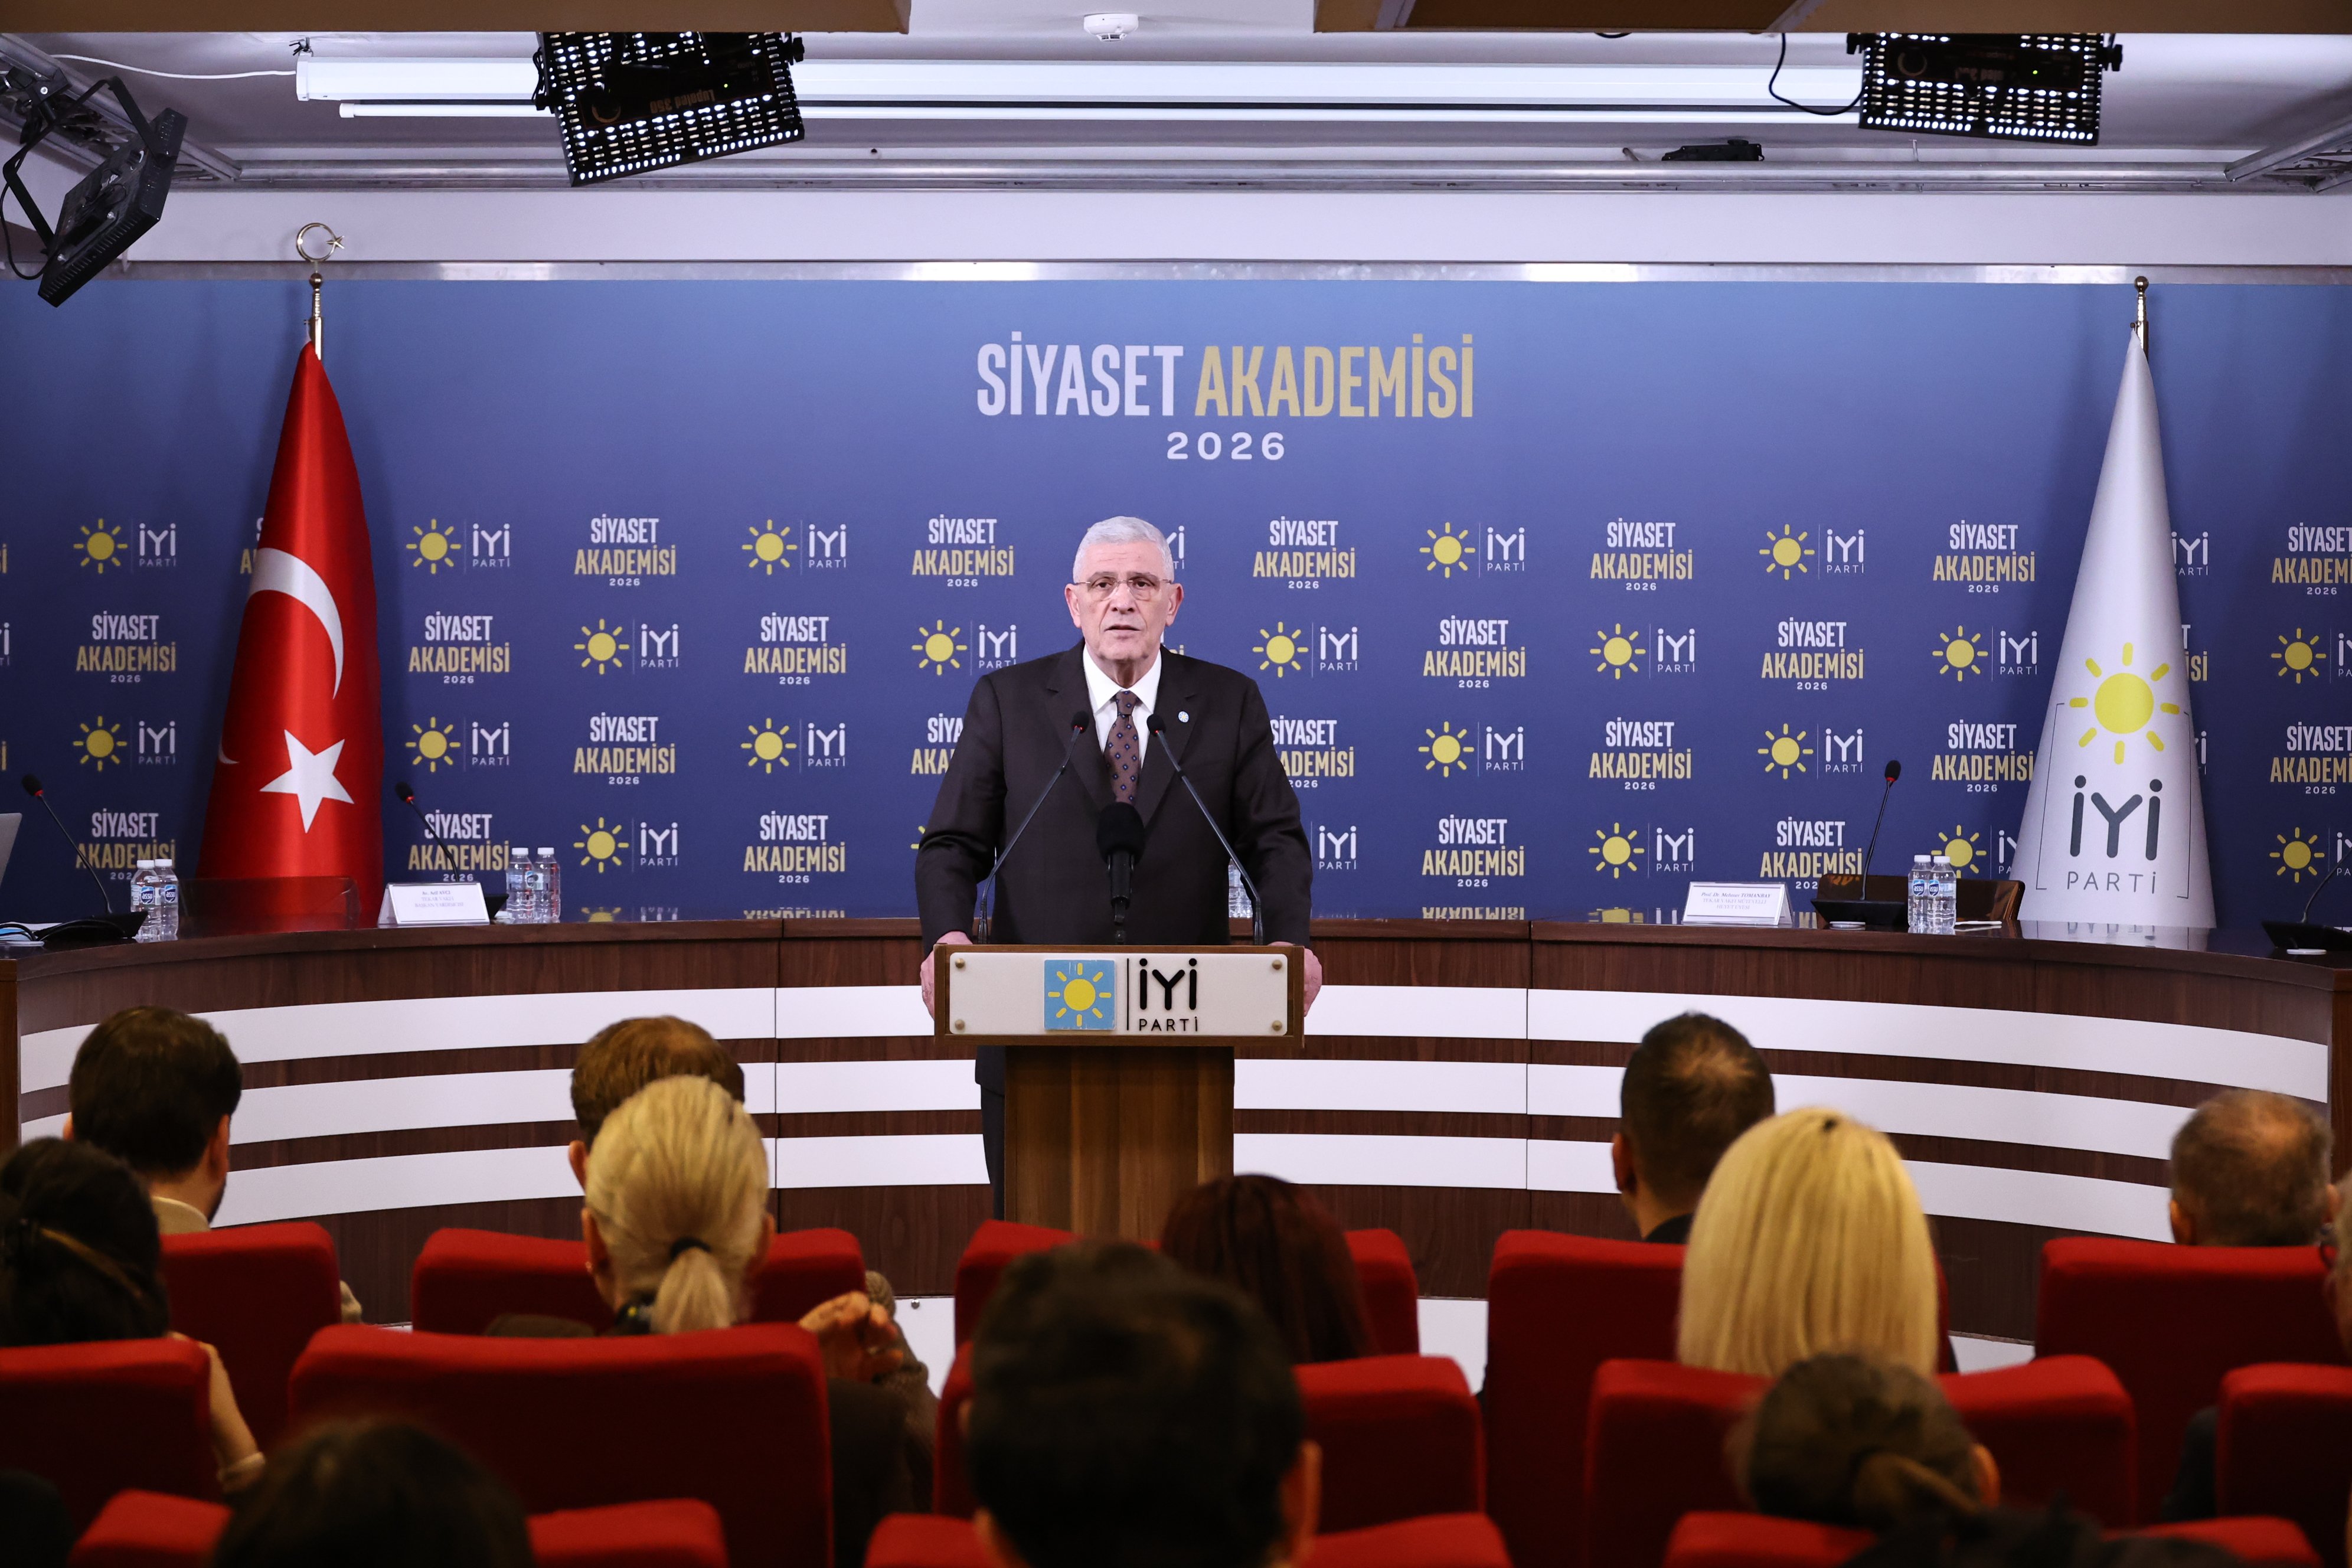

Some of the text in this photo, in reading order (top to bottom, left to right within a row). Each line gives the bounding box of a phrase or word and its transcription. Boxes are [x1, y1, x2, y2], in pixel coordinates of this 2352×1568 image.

[978, 331, 1473, 418] SİYASET AKADEMİSİ
[1168, 432, 1284, 460] 2026
[139, 523, 176, 556] İYİ
[473, 524, 509, 557] İYİ
[591, 514, 659, 543] SİYASET
[809, 524, 846, 557] İYİ
[929, 514, 997, 544] SİYASET
[1270, 516, 1338, 545] SİYASET
[1607, 518, 1675, 547] SİYASET
[1950, 520, 2018, 550] SİYASET
[1488, 527, 1524, 561] İYİ
[1827, 529, 1864, 563] İYİ
[139, 558, 176, 567] PARTİ
[473, 557, 509, 567] PARTİ
[574, 545, 675, 575] AKADEMİSİ
[809, 558, 846, 568] PARTİ
[912, 545, 1014, 576] AKADEMİSİ
[1253, 547, 1355, 578] AKADEMİSİ
[1487, 561, 1524, 571] PARTİ
[1590, 549, 1692, 580] AKADEMİSİ
[1827, 563, 1864, 573] PARTİ
[1933, 551, 2034, 582] AKADEMİSİ
[2178, 566, 2208, 576] ARTİ
[948, 579, 978, 587] 2026
[1968, 584, 1998, 593] 2026
[92, 610, 159, 640] SİYASET
[425, 611, 493, 641] SİYASET
[641, 623, 678, 657] İYİ
[761, 612, 829, 642] SİYASET
[1440, 615, 1508, 645] SİYASET
[1778, 617, 1847, 647] SİYASET
[76, 642, 176, 671] AKADEMİSİ
[979, 625, 1016, 658] İYİ
[1320, 626, 1357, 660] İYİ
[1658, 628, 1695, 662] İYİ
[2000, 631, 2037, 664] İYİ
[409, 642, 509, 672] AKADEMİSİ
[641, 658, 678, 668] PARTİ
[744, 643, 846, 673] AKADEMİSİ
[1320, 661, 1357, 671] PARTİ
[1423, 646, 1525, 677] AKADEMİSİ
[1658, 663, 1694, 672] PARTİ
[1762, 648, 1863, 679] AKADEMİSİ
[2000, 665, 2037, 675] PARTİ
[444, 675, 474, 684] 2026
[1797, 682, 1827, 690] 2026
[139, 721, 175, 754] İYİ
[472, 722, 509, 755] İYİ
[590, 712, 658, 741] SİYASET
[808, 723, 845, 756] İYİ
[927, 713, 963, 743] SİYA
[1606, 717, 1674, 747] SİYASET
[1948, 719, 2017, 749] SİYASET
[574, 743, 675, 773] AKADEMİSİ
[1486, 726, 1523, 760] İYİ
[1825, 729, 1863, 762] İYİ
[139, 756, 175, 764] PARTİ
[472, 756, 509, 765] PARTİ
[808, 757, 845, 766] PARTİ
[1486, 760, 1523, 770] PARTİ
[1589, 749, 1691, 779] AKADEMİSİ
[1825, 763, 1862, 772] PARTİ
[1932, 751, 2033, 780] AKADEMİSİ
[609, 776, 639, 785] 2026
[1625, 782, 1655, 790] 2026
[1967, 784, 1997, 792] 2026
[92, 808, 159, 837] SİYASET
[424, 809, 492, 839] SİYASET
[760, 811, 828, 840] SİYASET
[1439, 814, 1507, 844] SİYASET
[1777, 816, 1845, 846] SİYASET
[2070, 775, 2162, 861] İYİ
[641, 822, 678, 855] İYİ
[1319, 825, 1356, 859] İYİ
[1657, 828, 1694, 861] İYİ
[641, 857, 678, 865] PARTİ
[744, 842, 845, 872] AKADEMİSİ
[1319, 860, 1356, 870] PARTİ
[1422, 845, 1524, 876] AKADEMİSİ
[1657, 862, 1693, 871] PARTİ
[1760, 848, 1862, 879] AKADEMİSİ
[779, 875, 809, 883] 2026
[2067, 871, 2156, 894] PARTİ
[1139, 958, 1197, 1011] İYİ
[1139, 1016, 1198, 1032] PARTİ
